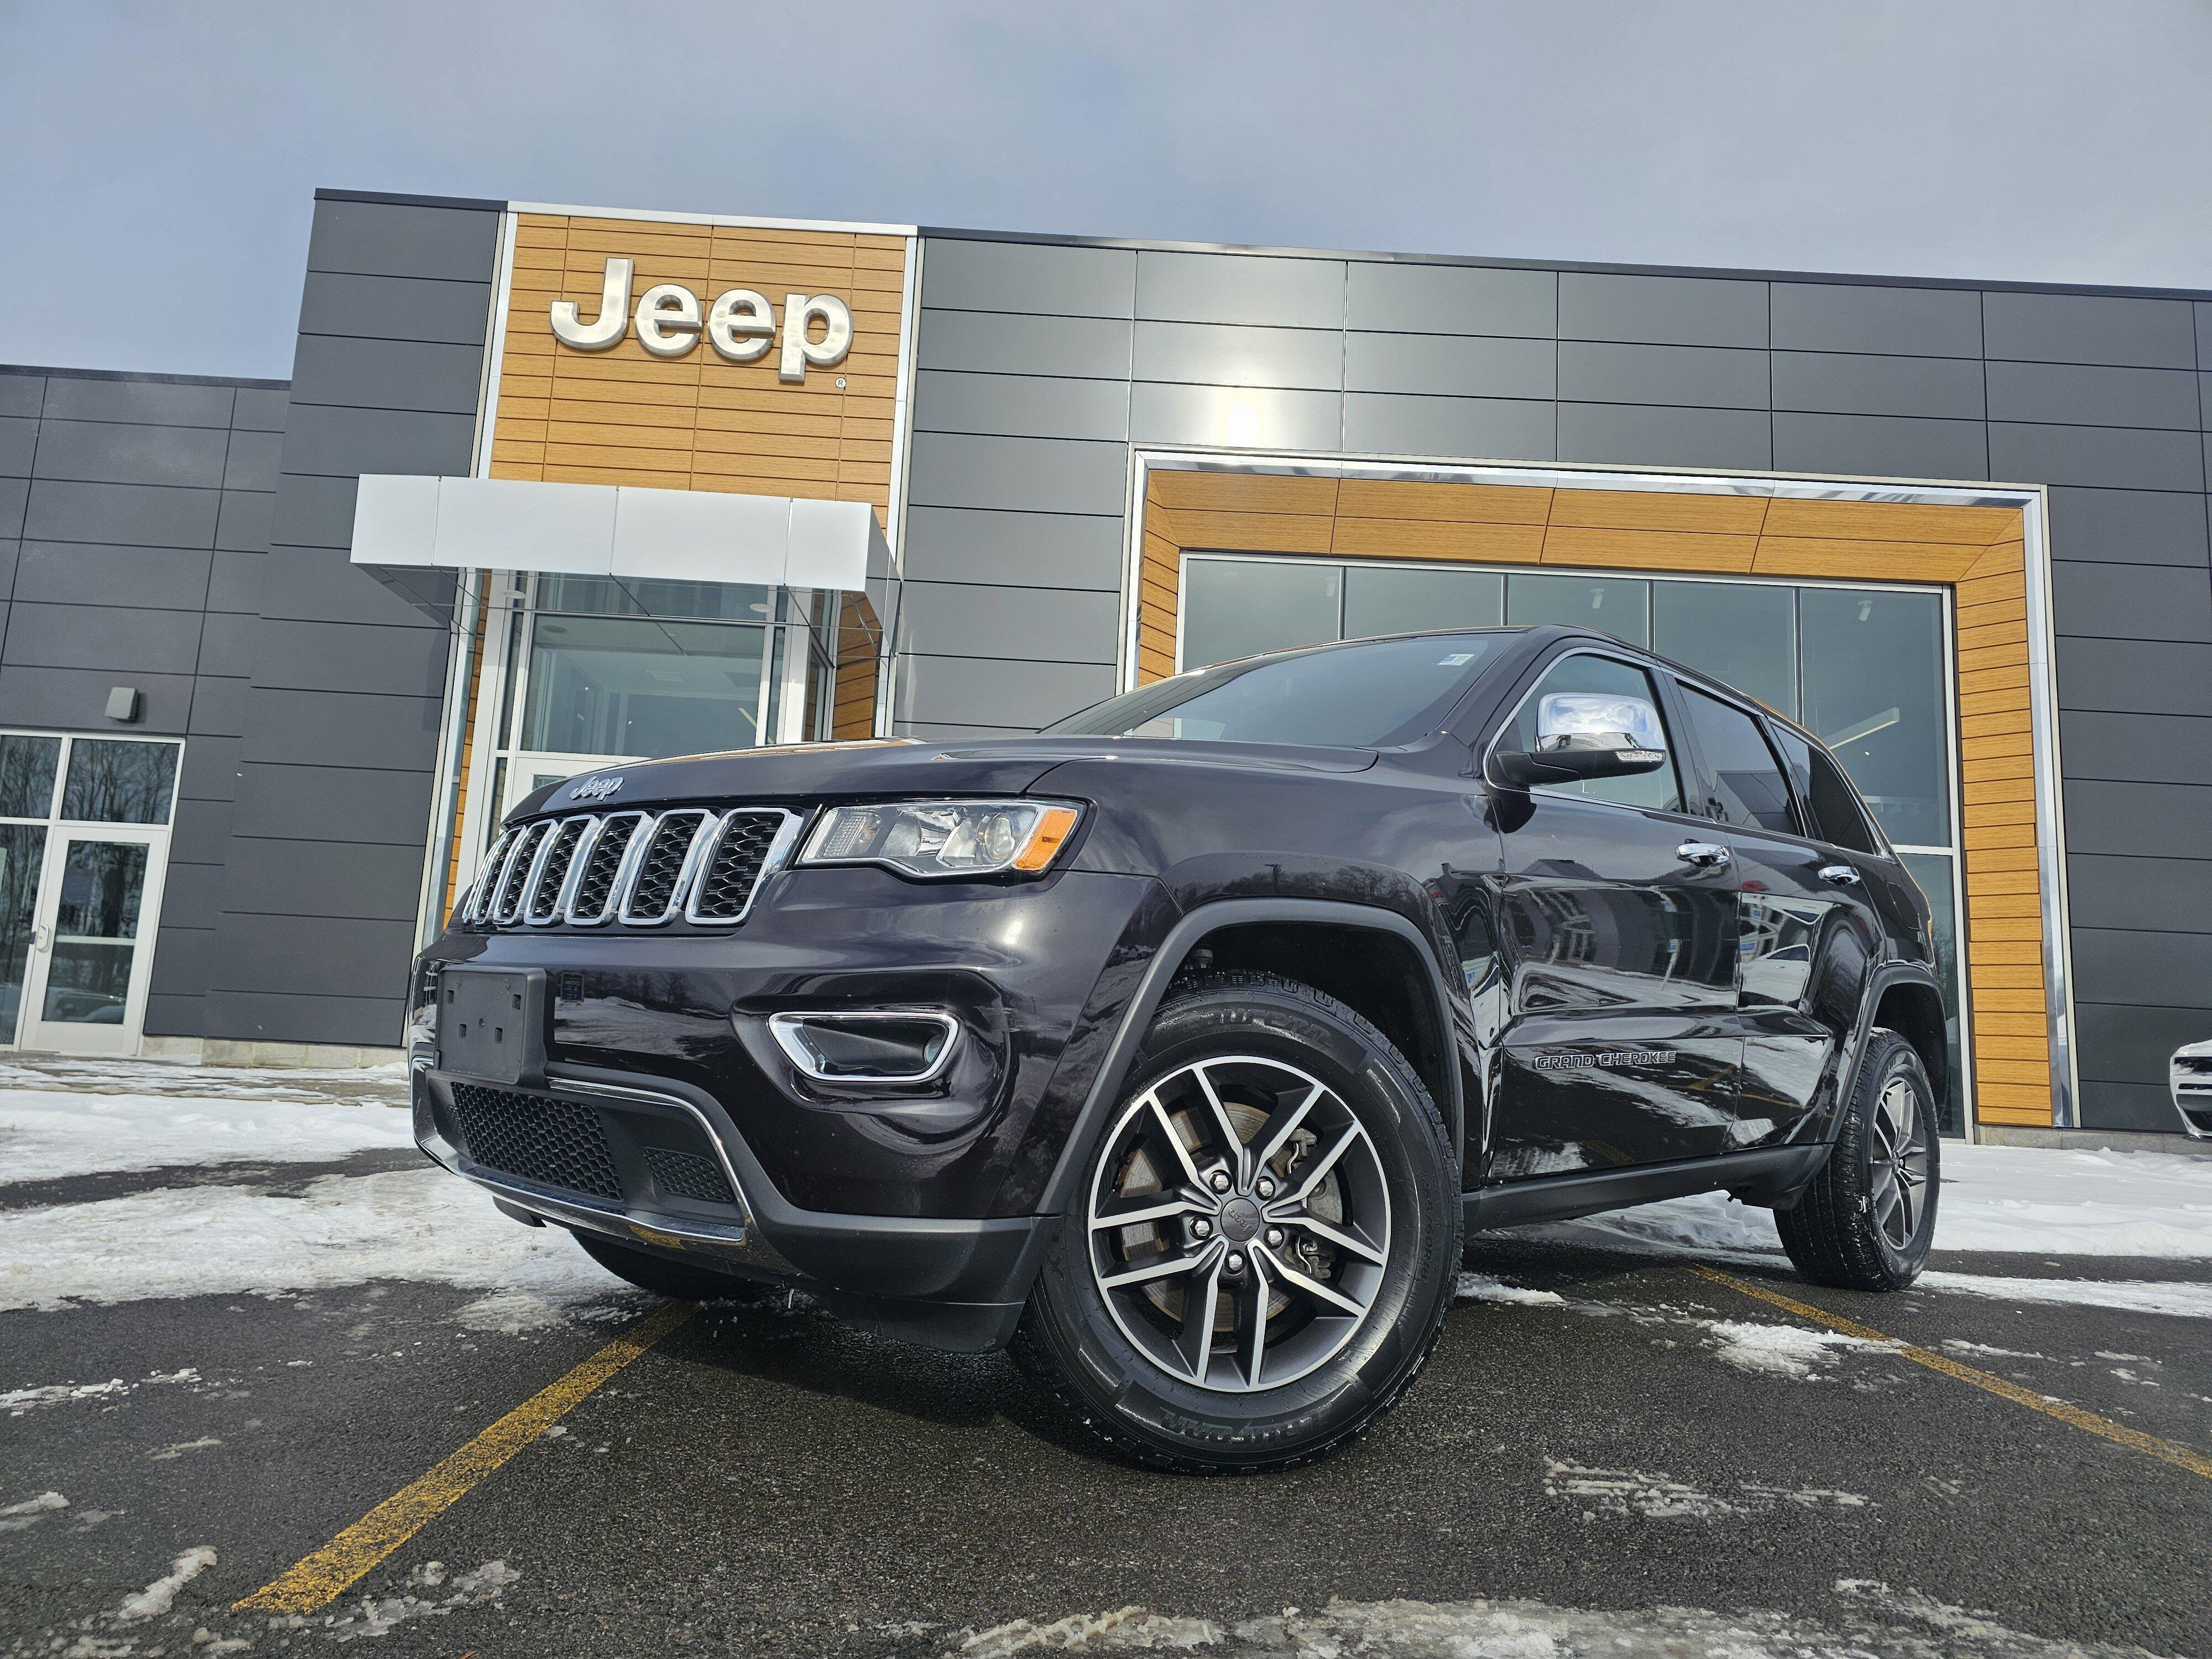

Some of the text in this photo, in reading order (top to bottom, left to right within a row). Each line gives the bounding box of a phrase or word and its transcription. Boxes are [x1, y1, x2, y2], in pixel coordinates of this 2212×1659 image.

[550, 257, 854, 382] Jeep
[569, 776, 623, 801] Jeep
[1533, 1051, 1676, 1070] GRAND CHEROKEE
[1228, 1208, 1252, 1233] Jeep
